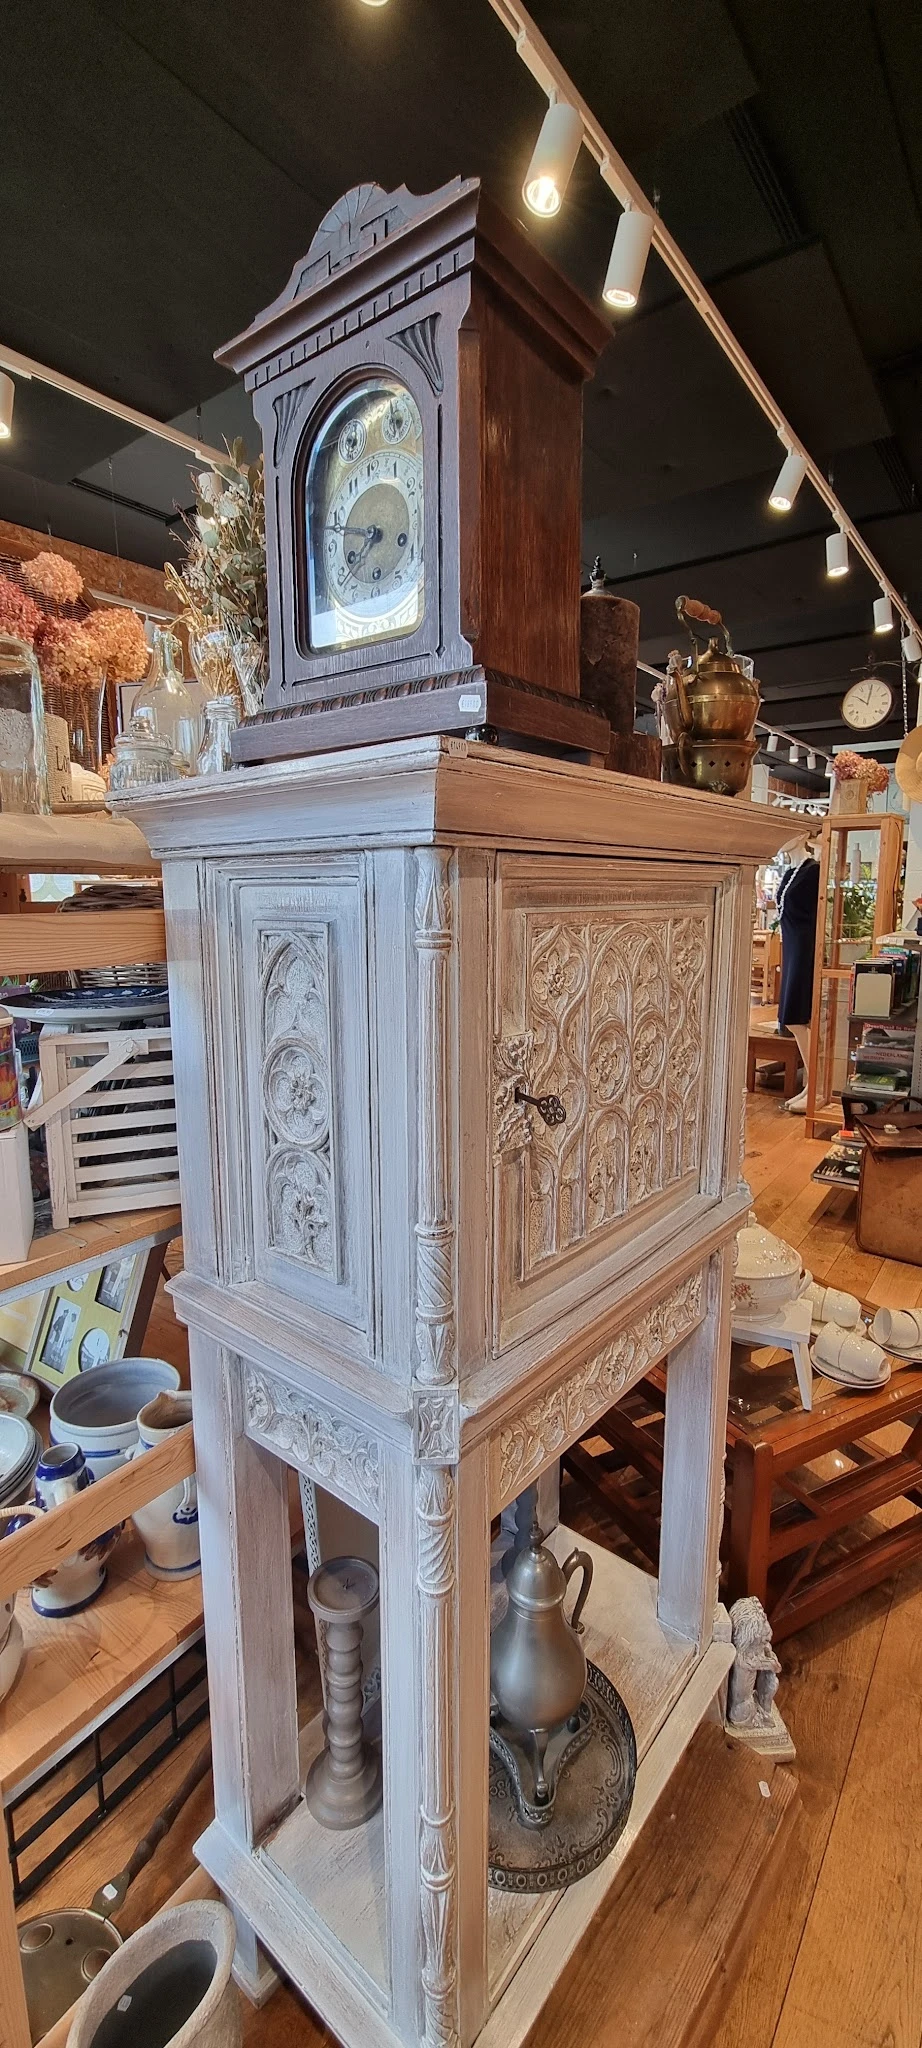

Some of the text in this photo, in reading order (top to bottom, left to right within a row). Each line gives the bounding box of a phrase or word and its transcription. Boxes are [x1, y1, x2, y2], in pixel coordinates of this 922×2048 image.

[366, 460, 380, 480] 12
[348, 477, 358, 499] 11
[407, 476, 416, 498] 2
[333, 506, 346, 526] 10
[328, 539, 338, 558] 9
[337, 567, 346, 587] 8
[392, 569, 402, 590] 5
[350, 584, 359, 602] 7
